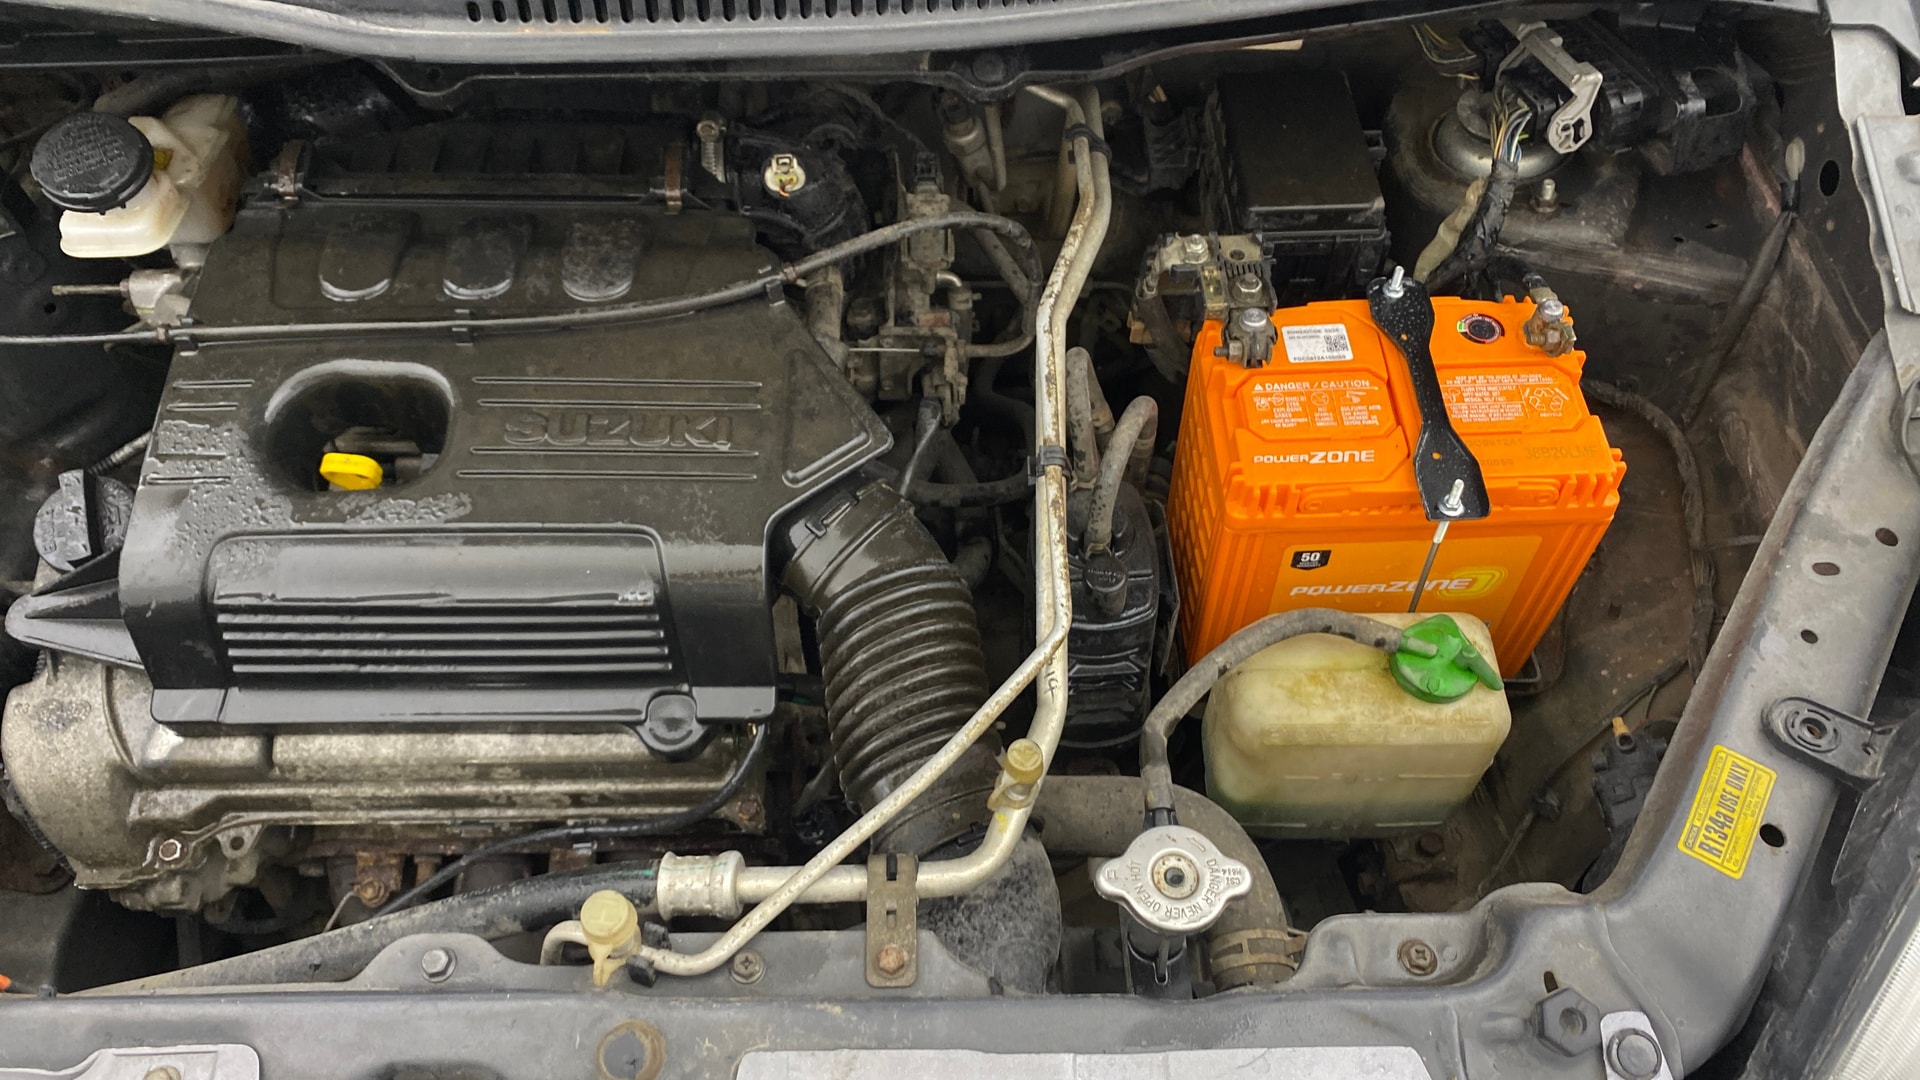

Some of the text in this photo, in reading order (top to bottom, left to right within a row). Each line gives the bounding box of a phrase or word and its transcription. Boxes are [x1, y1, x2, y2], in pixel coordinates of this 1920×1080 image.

[1264, 381, 1310, 392] DANGER
[1320, 379, 1370, 390] CAUTION
[503, 411, 732, 451] SUZUKI
[1253, 449, 1375, 465] POWERZONE
[1300, 551, 1321, 562] 50
[1724, 759, 1750, 791] ONLY
[1716, 787, 1740, 814] USE
[1697, 809, 1734, 858] R134a
[1126, 858, 1221, 919] DANGER NEVER OPEN HOT
